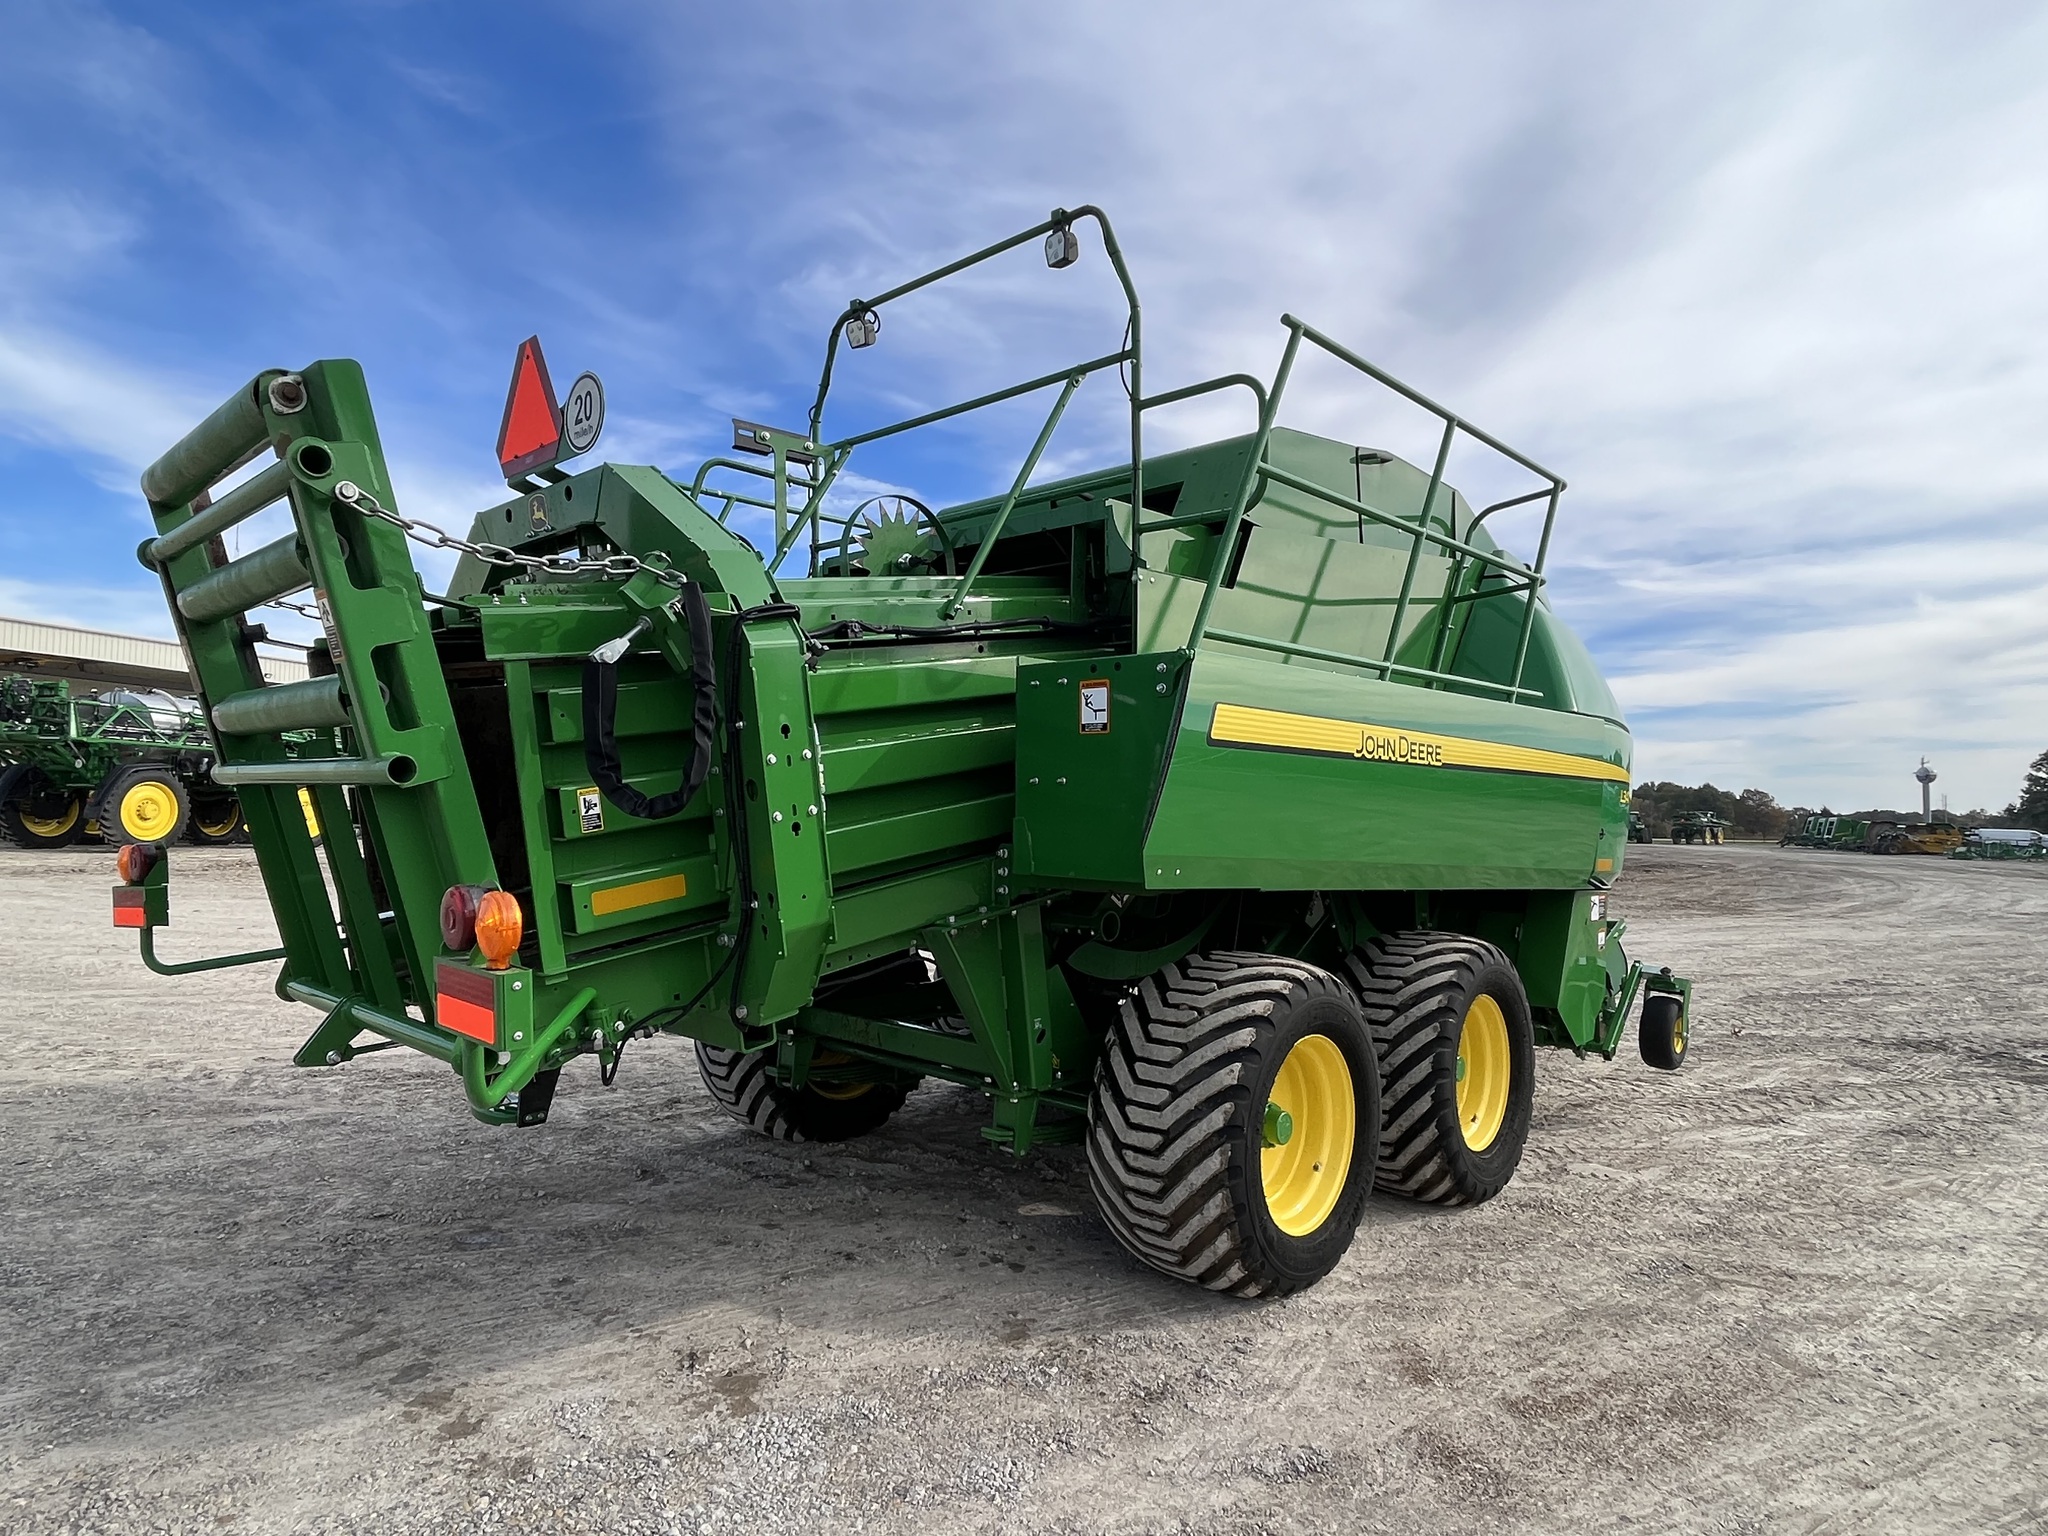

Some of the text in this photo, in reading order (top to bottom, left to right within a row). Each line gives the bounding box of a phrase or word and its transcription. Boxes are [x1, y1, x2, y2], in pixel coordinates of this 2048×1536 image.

[574, 390, 592, 426] 20
[1355, 730, 1442, 763] JOHN DEERE
